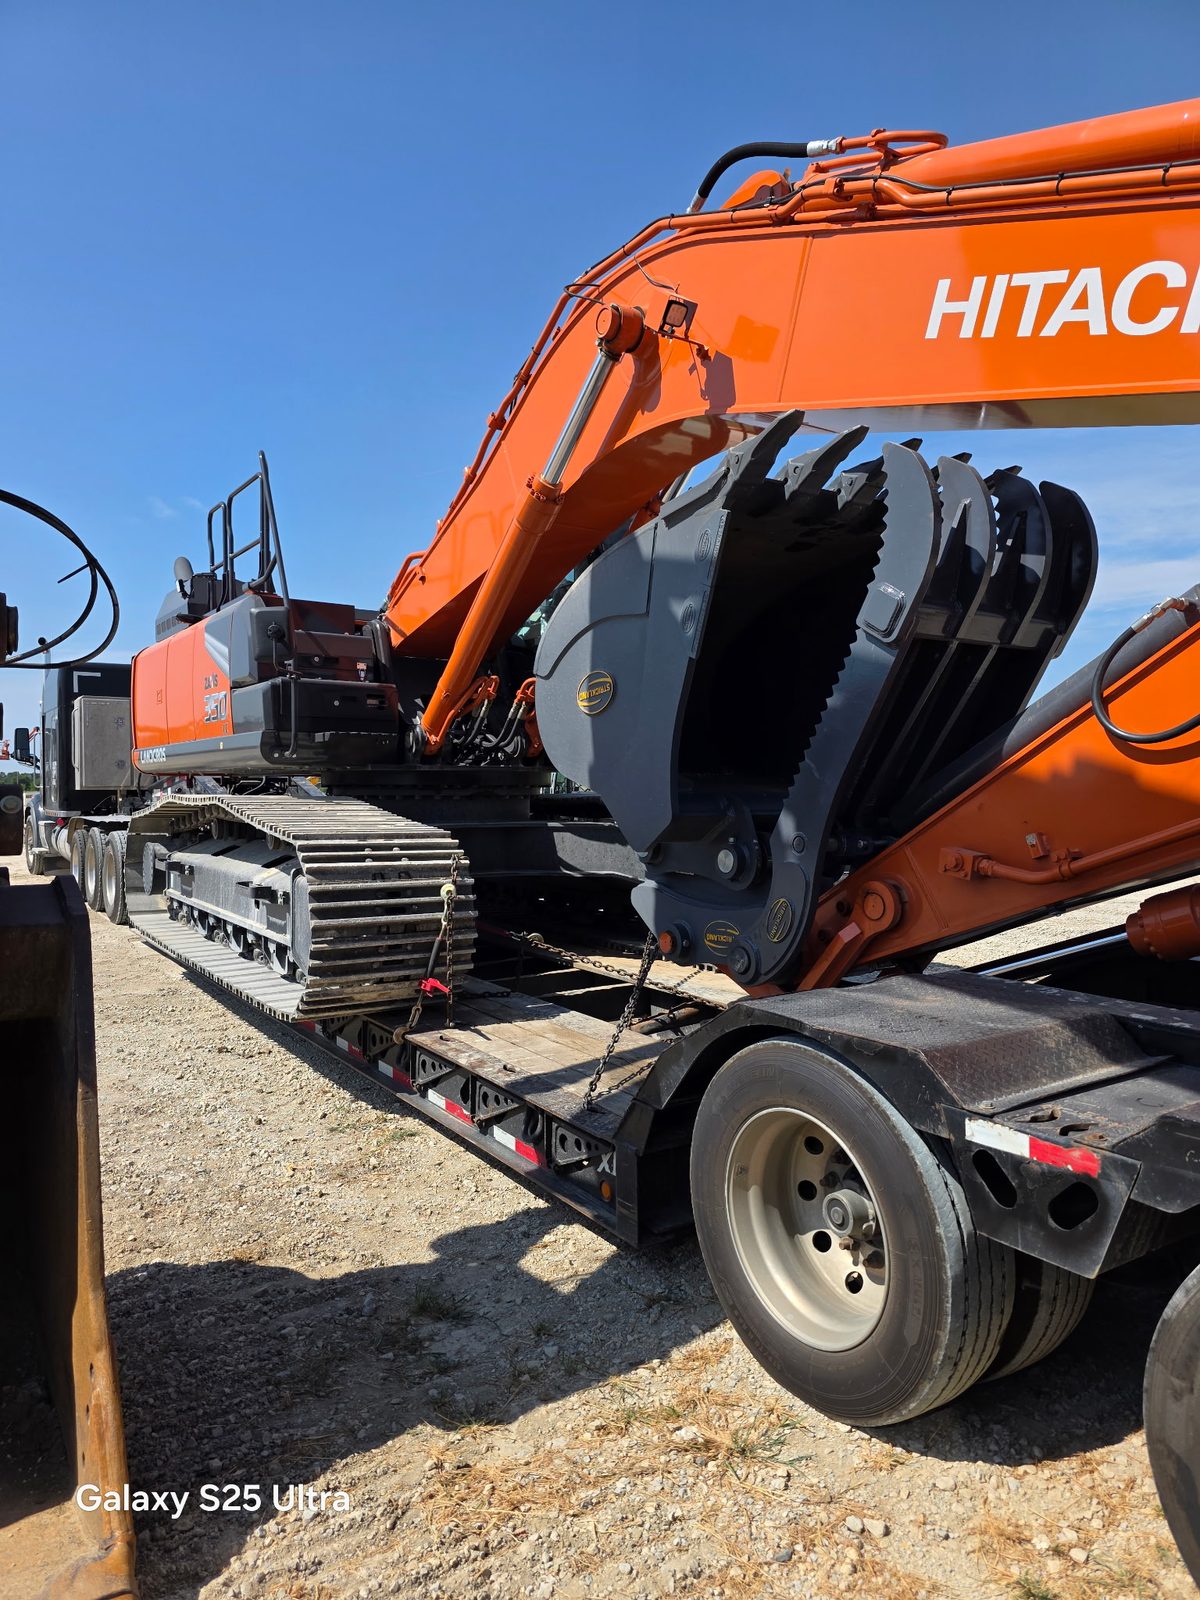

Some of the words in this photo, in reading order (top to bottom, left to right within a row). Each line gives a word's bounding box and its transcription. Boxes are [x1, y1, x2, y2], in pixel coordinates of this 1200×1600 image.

[204, 691, 227, 724] 350
[770, 901, 788, 939] STRICKLAND
[706, 932, 735, 943] RICKLAND
